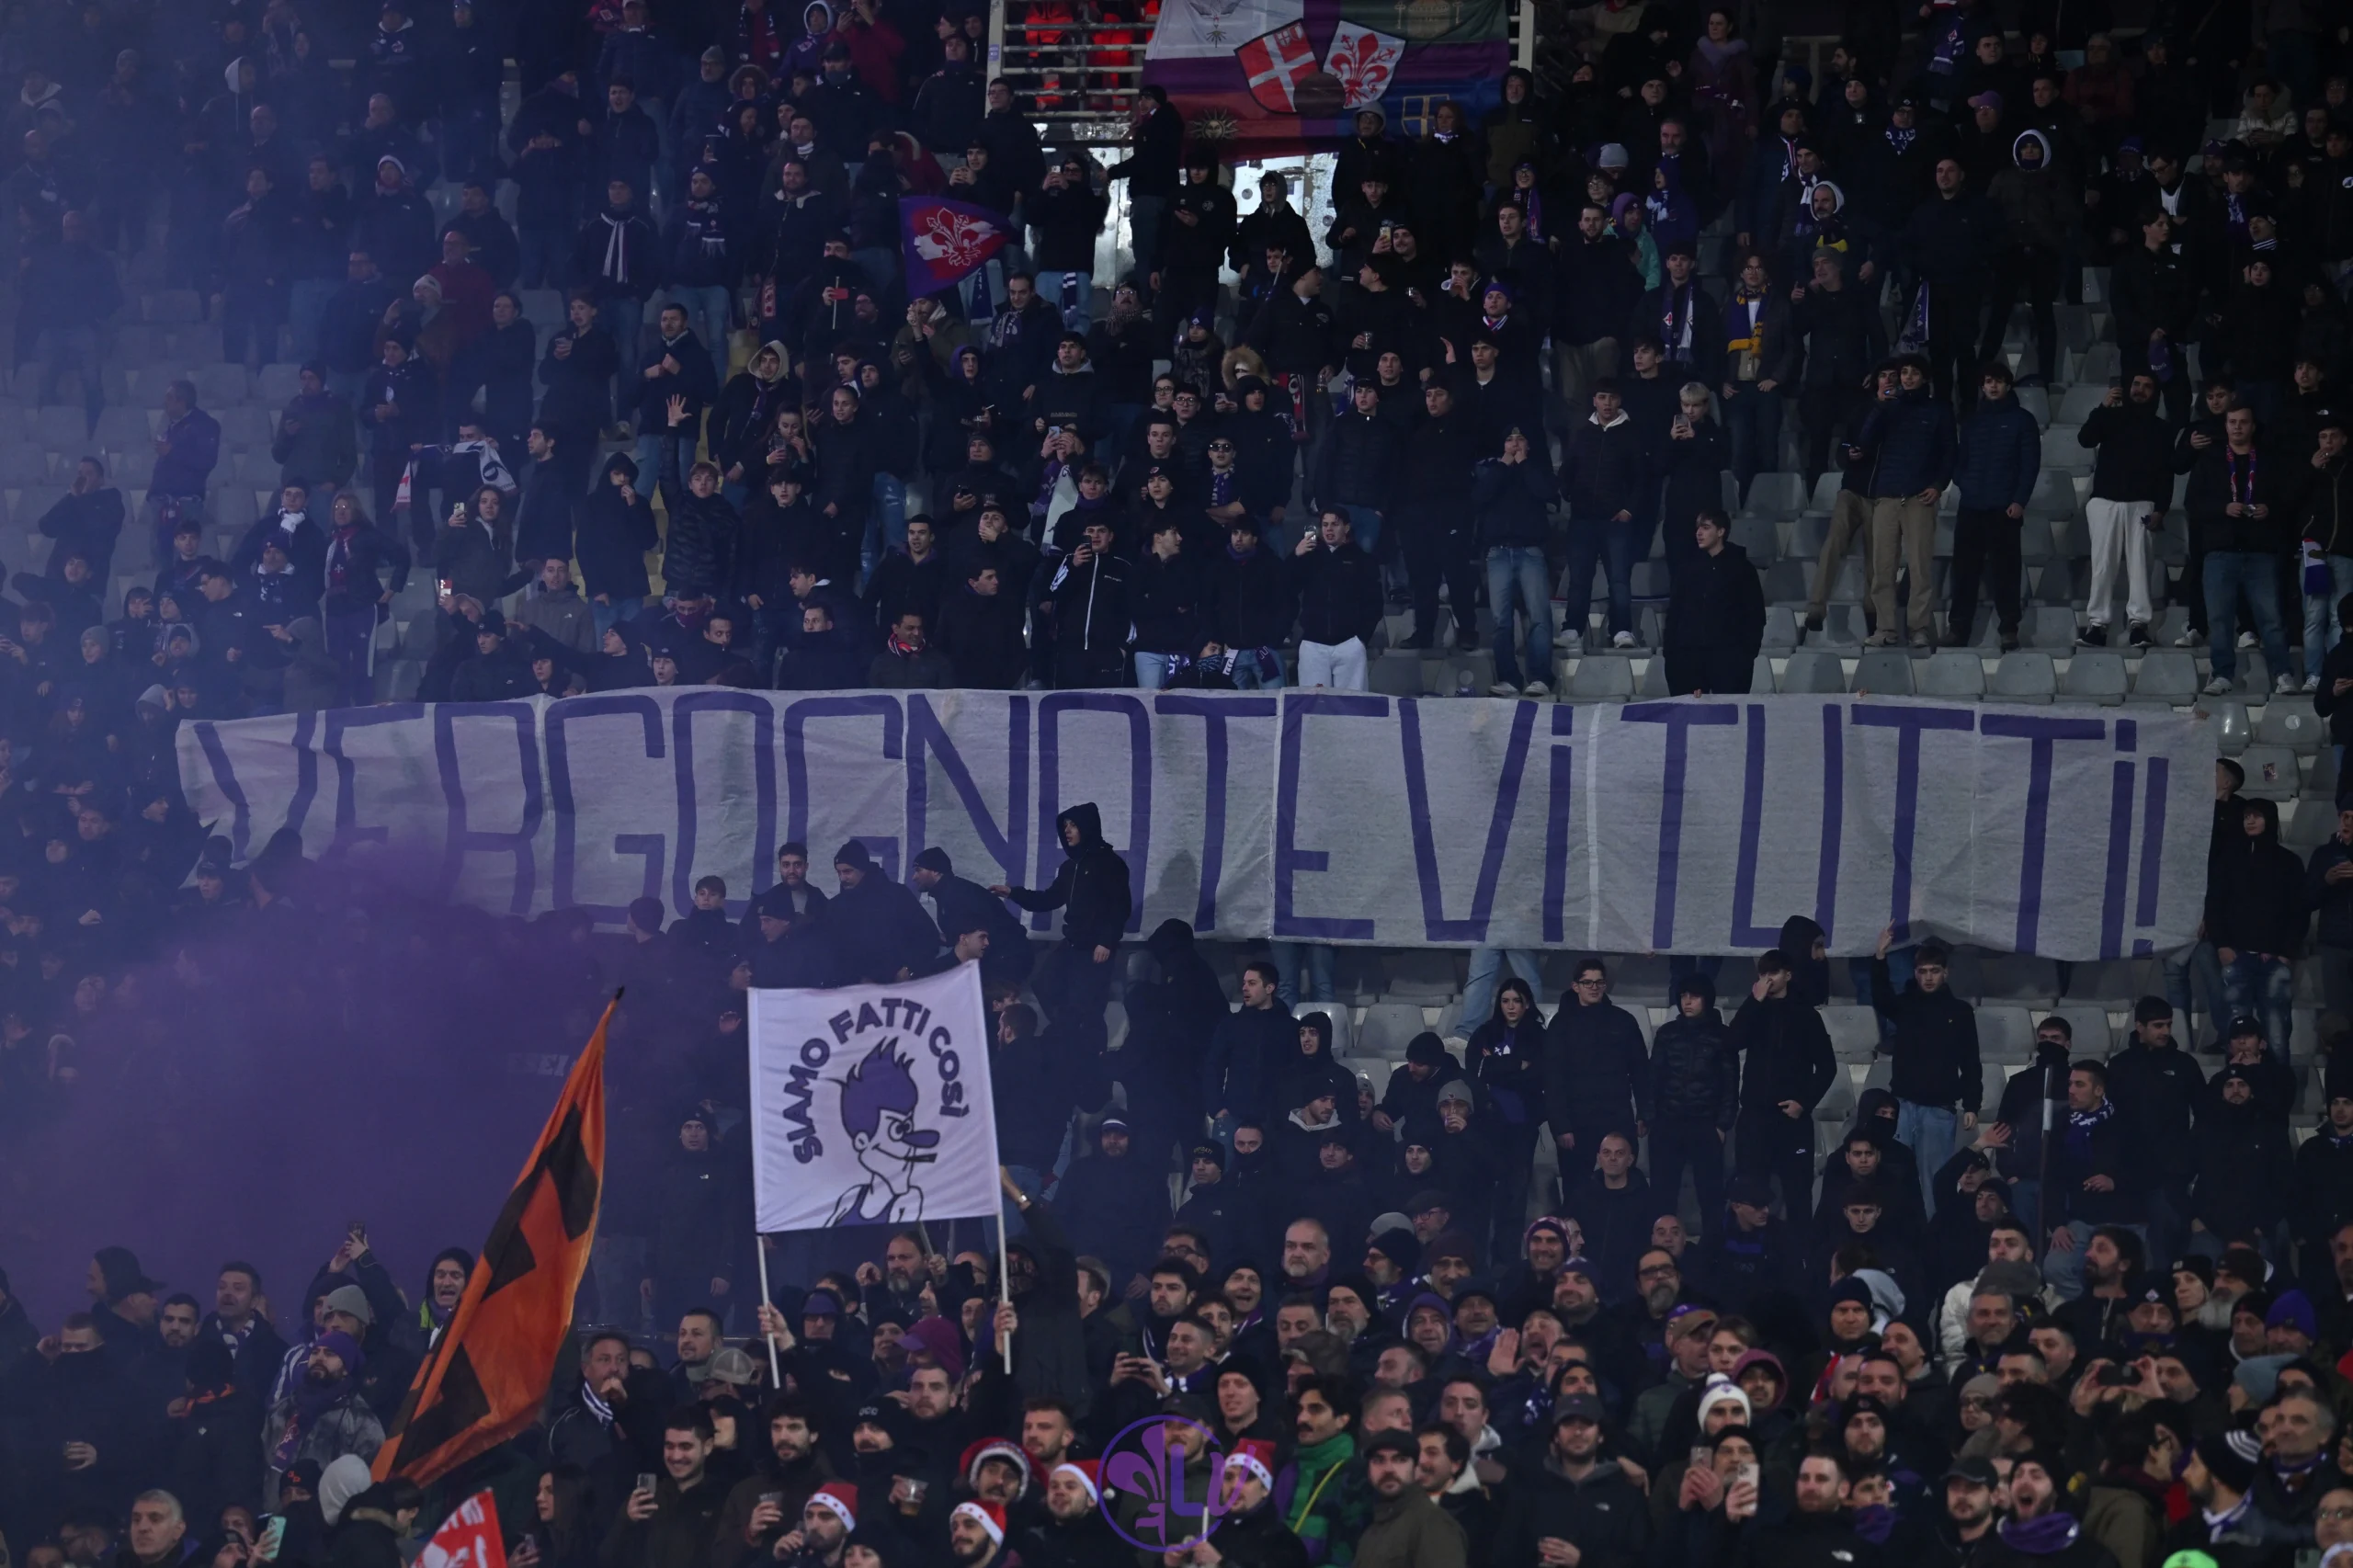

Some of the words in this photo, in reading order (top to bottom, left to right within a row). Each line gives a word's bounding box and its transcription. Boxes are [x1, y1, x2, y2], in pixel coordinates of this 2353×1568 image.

[783, 1038, 831, 1164] SIAMO
[828, 998, 931, 1045] FATTI
[928, 1026, 970, 1118] COSÌ
